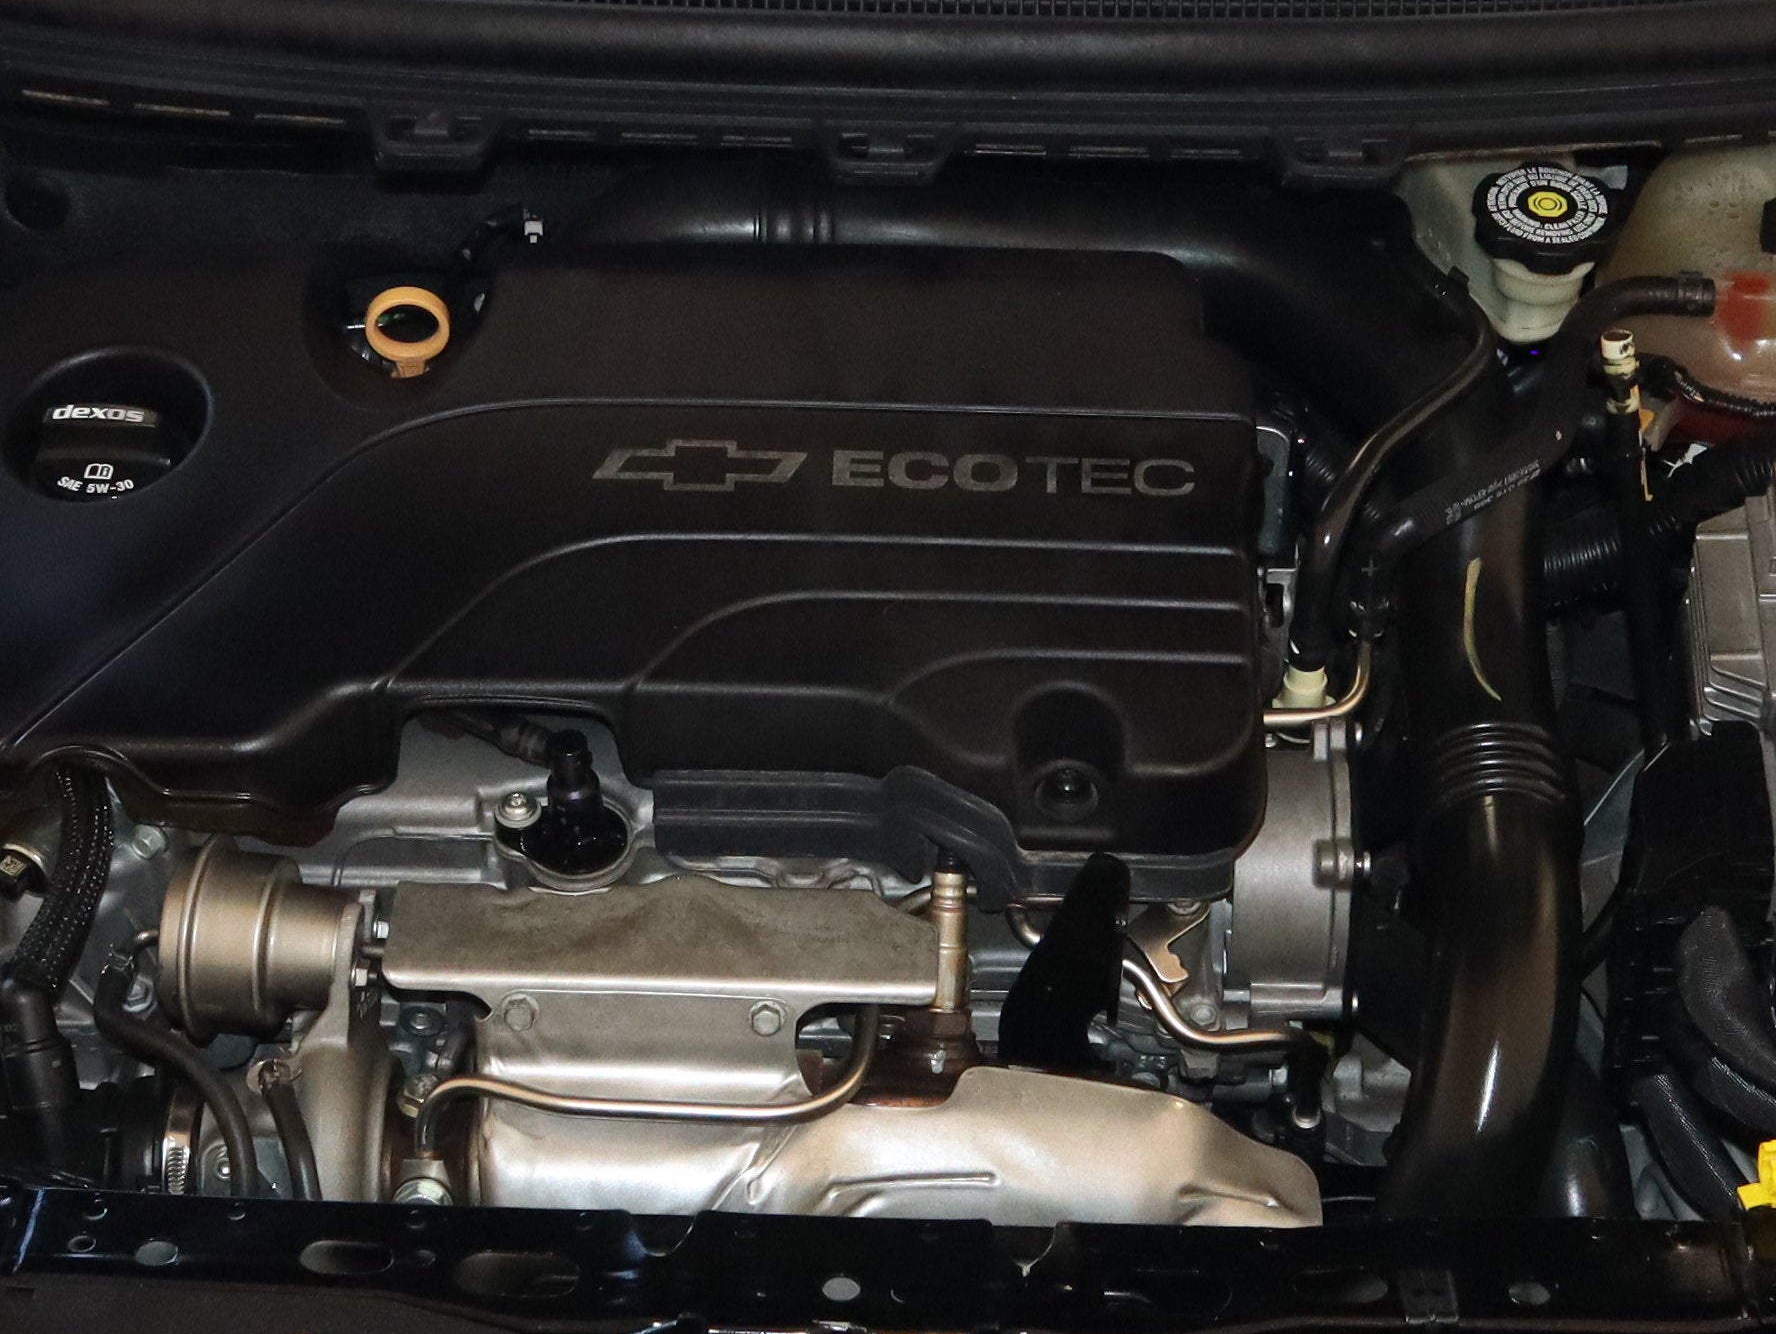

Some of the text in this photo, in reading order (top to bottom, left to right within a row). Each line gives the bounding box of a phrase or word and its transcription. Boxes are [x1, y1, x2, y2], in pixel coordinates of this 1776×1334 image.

[52, 404, 145, 423] dexos
[831, 449, 1196, 496] ECOTEC
[57, 476, 135, 494] SAE 5W-30
